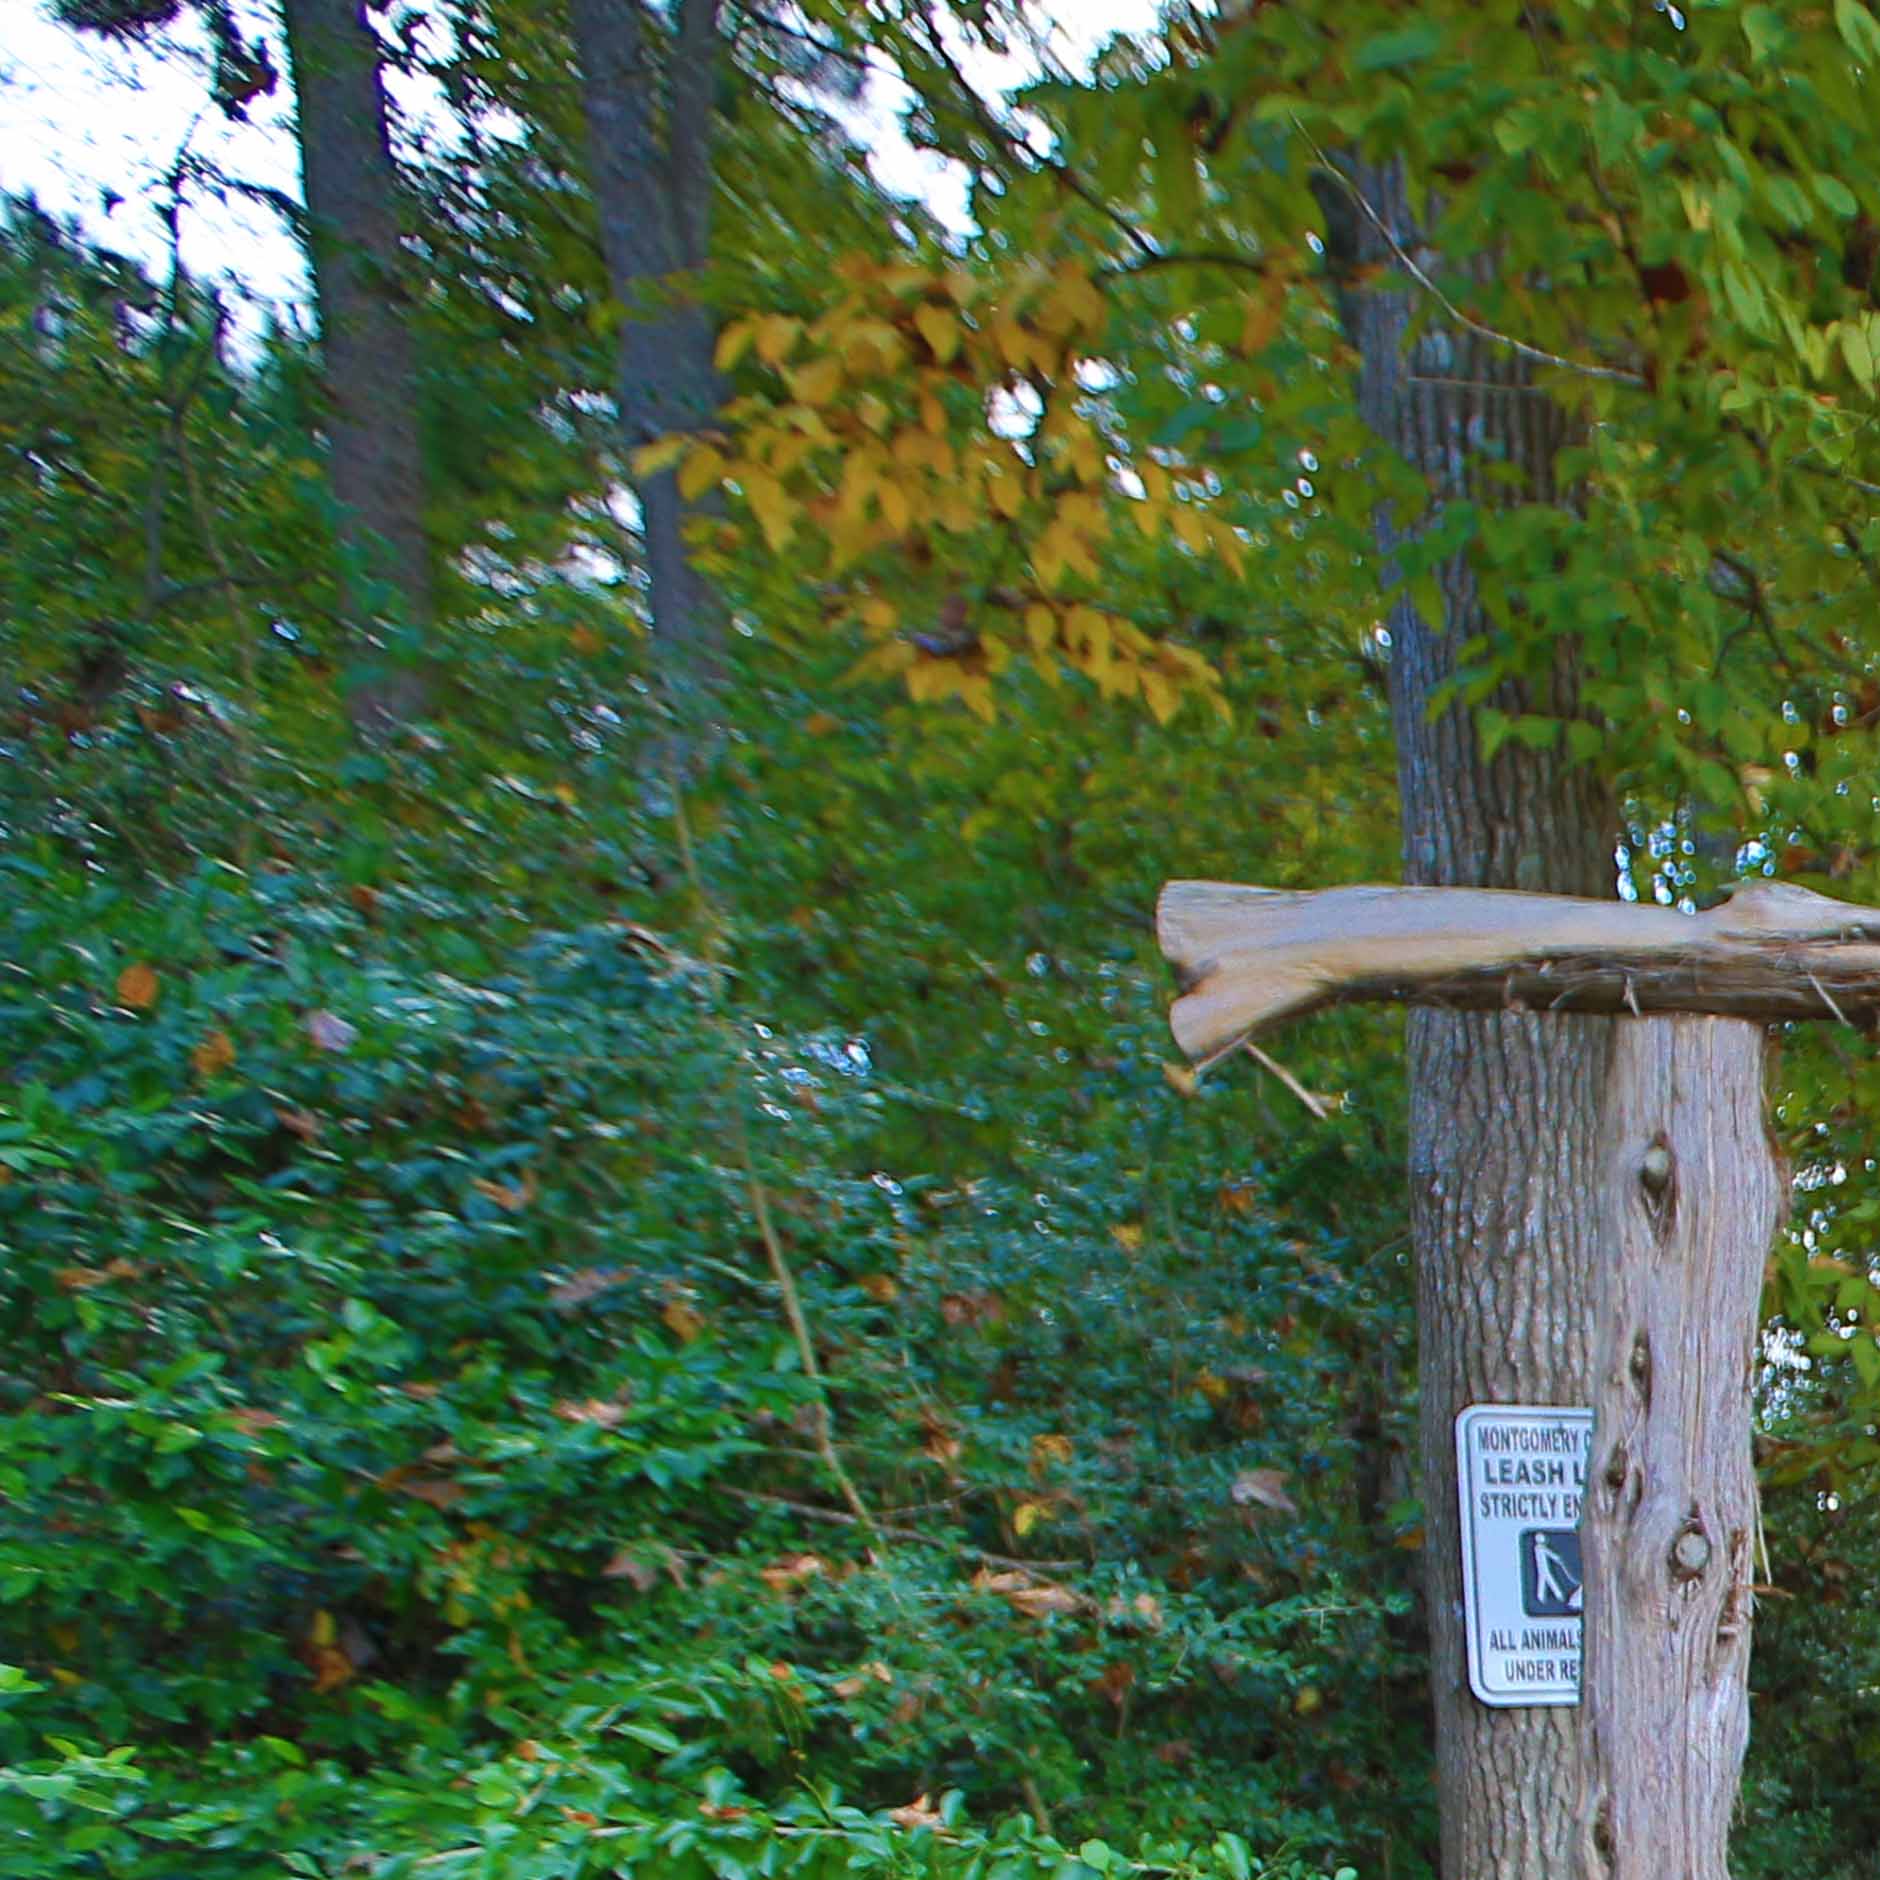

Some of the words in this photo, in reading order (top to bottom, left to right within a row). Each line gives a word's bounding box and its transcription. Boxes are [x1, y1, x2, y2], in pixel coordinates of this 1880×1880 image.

[1478, 1426, 1578, 1453] MONTGOMERY
[1483, 1459, 1564, 1486] LEASH
[1480, 1492, 1556, 1518] STRICTLY
[1489, 1629, 1516, 1651] ALL
[1505, 1660, 1555, 1681] UNDER
